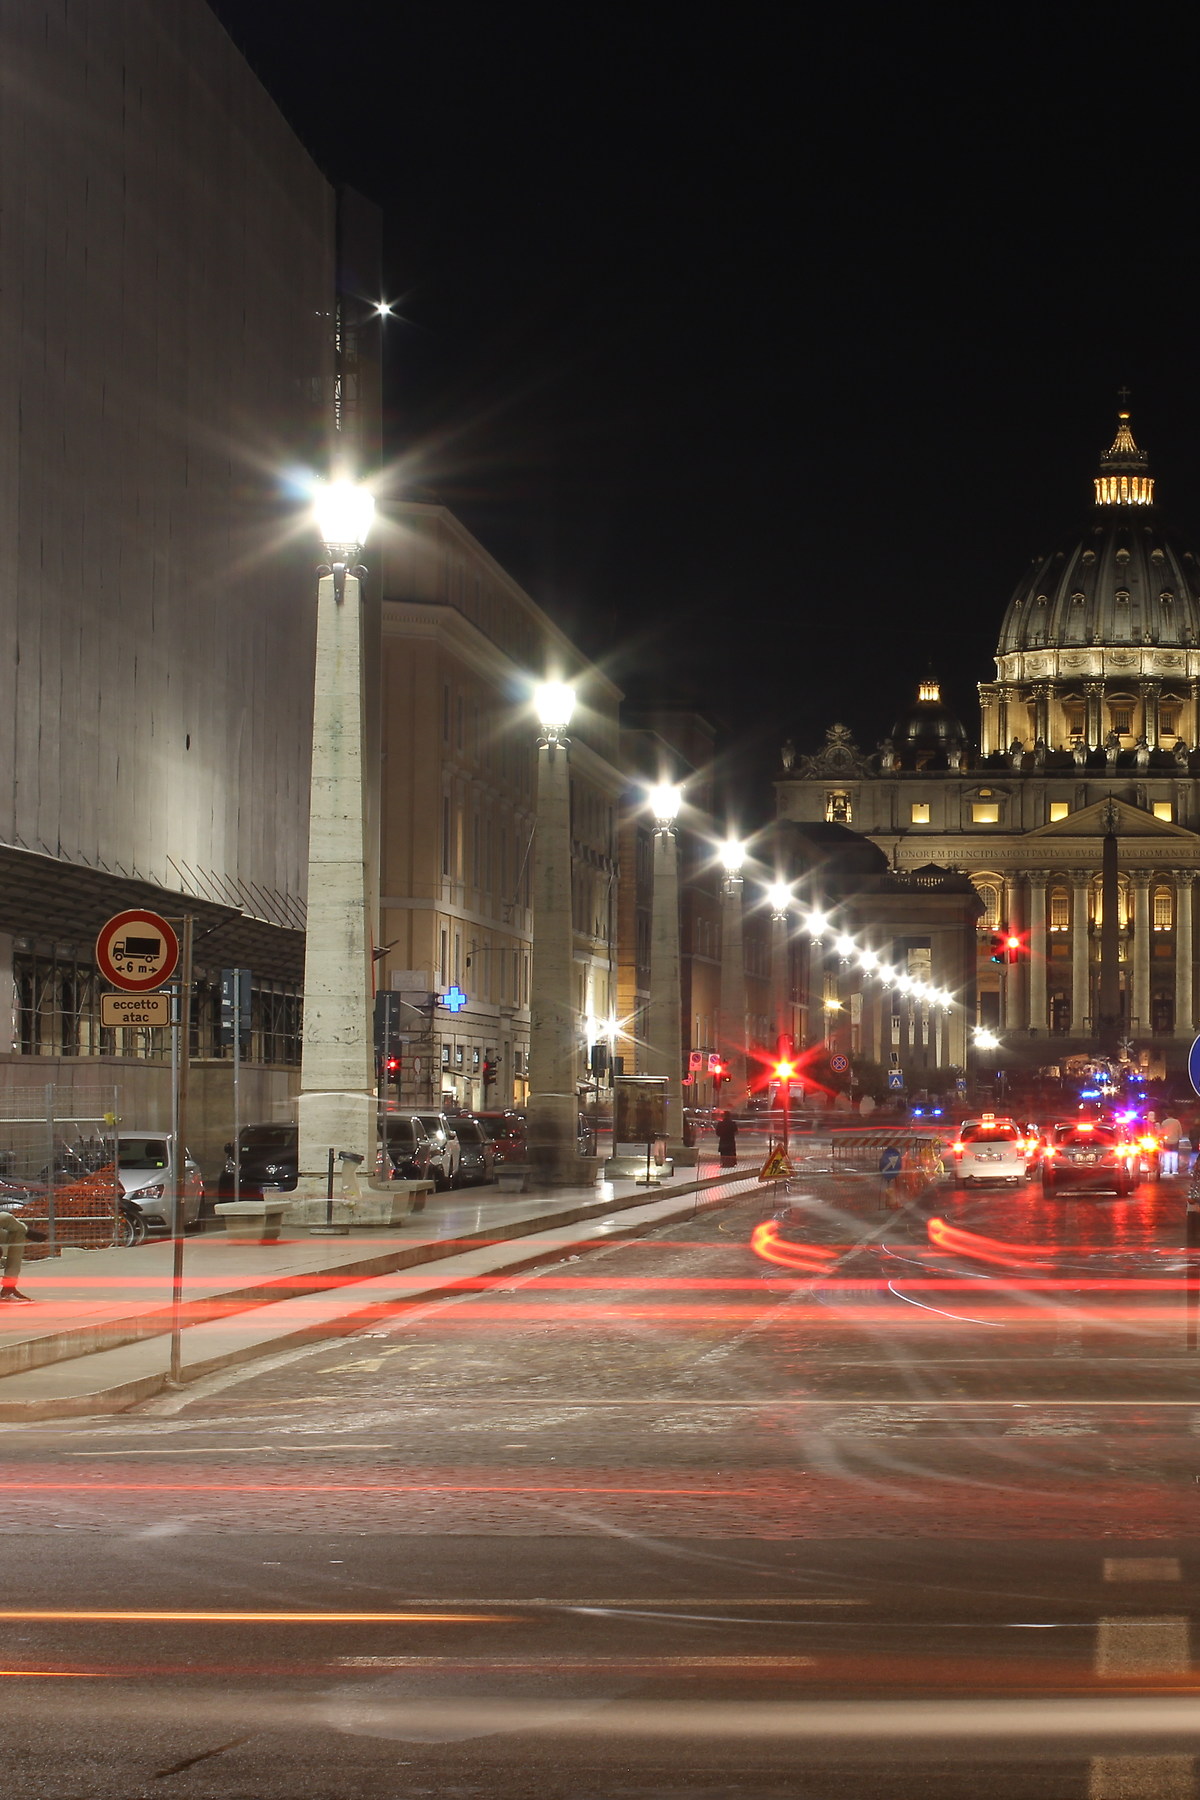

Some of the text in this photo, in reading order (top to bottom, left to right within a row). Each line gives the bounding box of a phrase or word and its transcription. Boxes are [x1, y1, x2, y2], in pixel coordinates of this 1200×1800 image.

[947, 850, 999, 858] PRINCIPIS
[1138, 849, 1191, 857] ROMANVS
[126, 961, 147, 973] 6 m
[113, 999, 159, 1010] eccetto
[122, 1012, 149, 1022] atac
